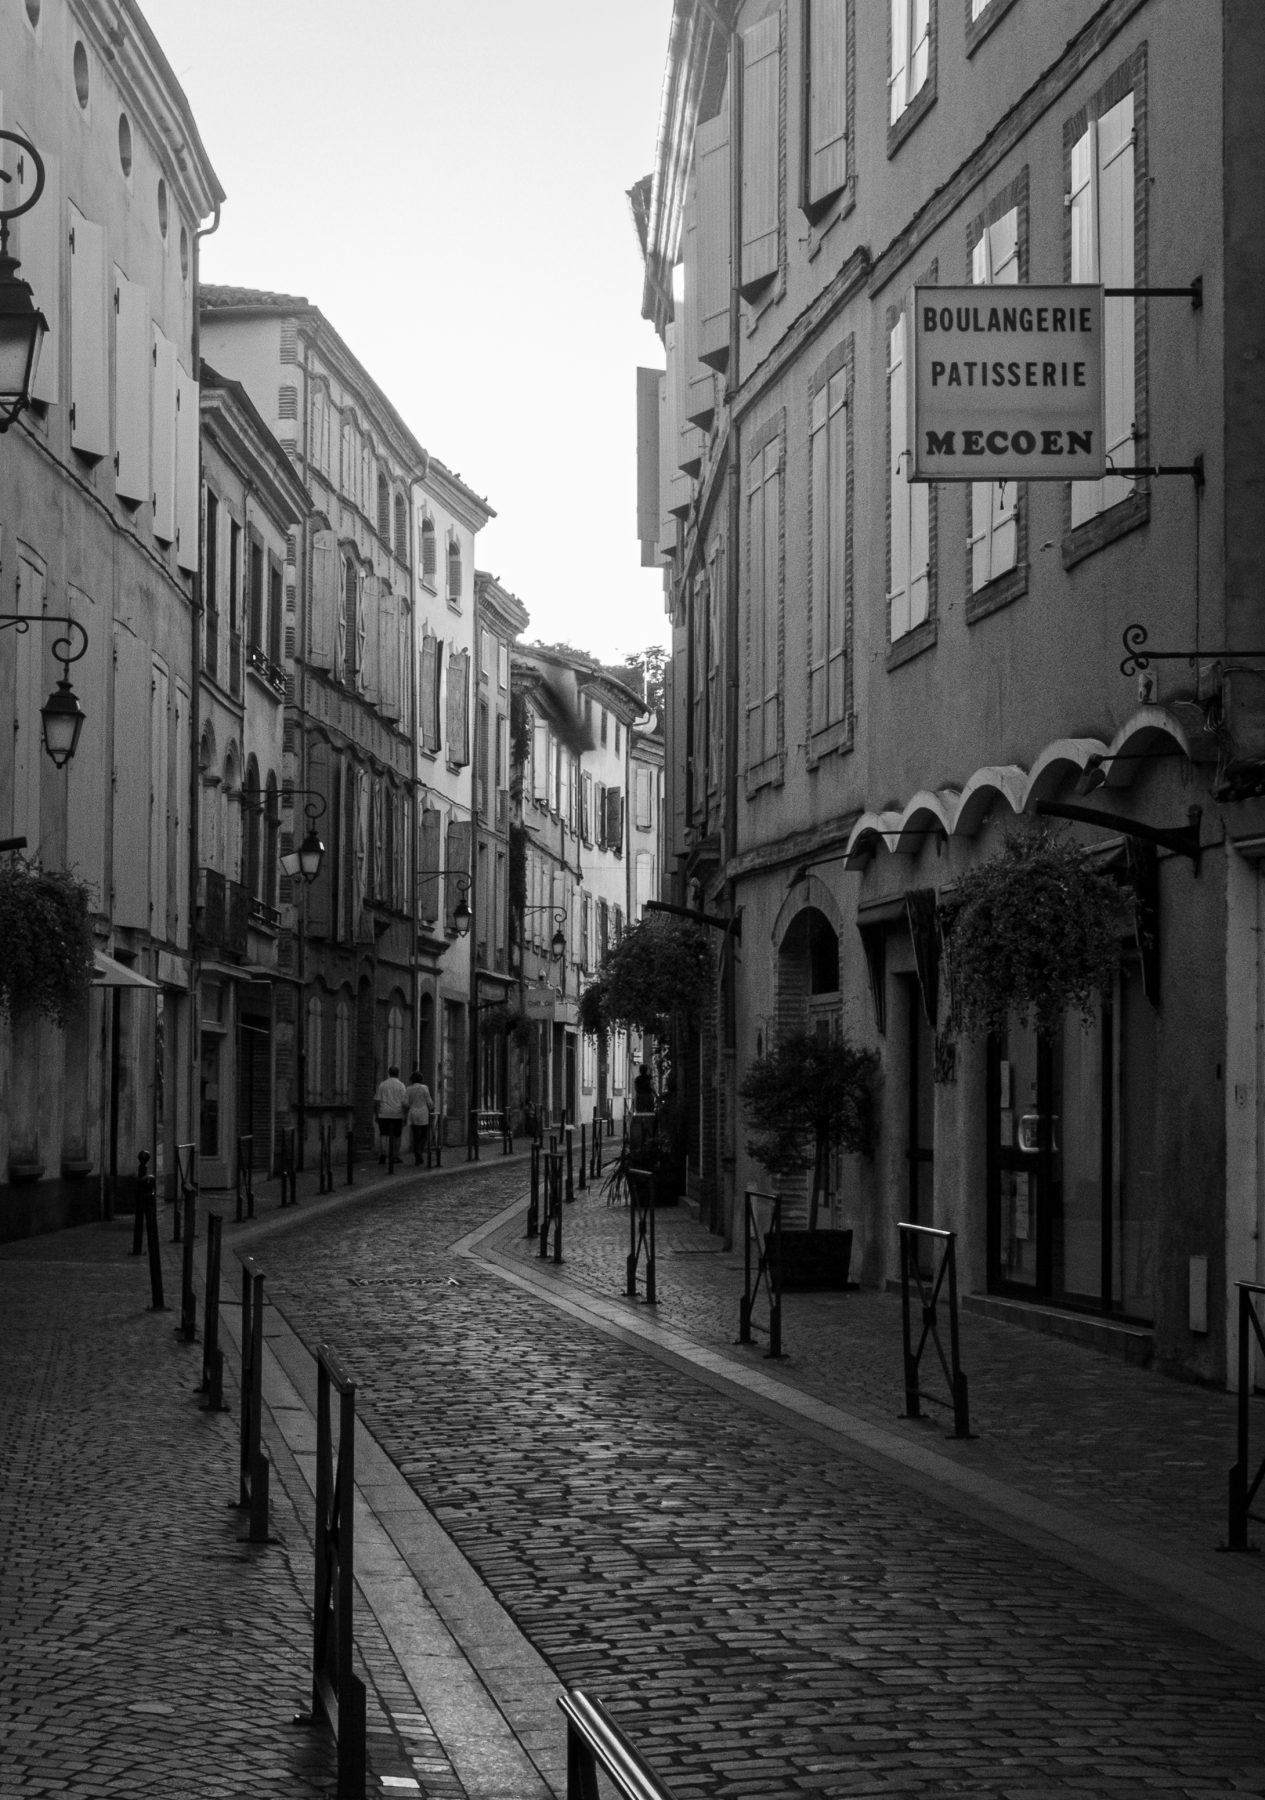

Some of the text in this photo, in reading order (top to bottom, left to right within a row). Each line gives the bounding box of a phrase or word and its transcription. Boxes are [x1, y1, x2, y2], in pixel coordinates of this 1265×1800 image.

[923, 306, 1092, 332] BOULANGERIE
[931, 361, 1086, 387] PATISSERIE
[925, 430, 1093, 456] MECOEN
